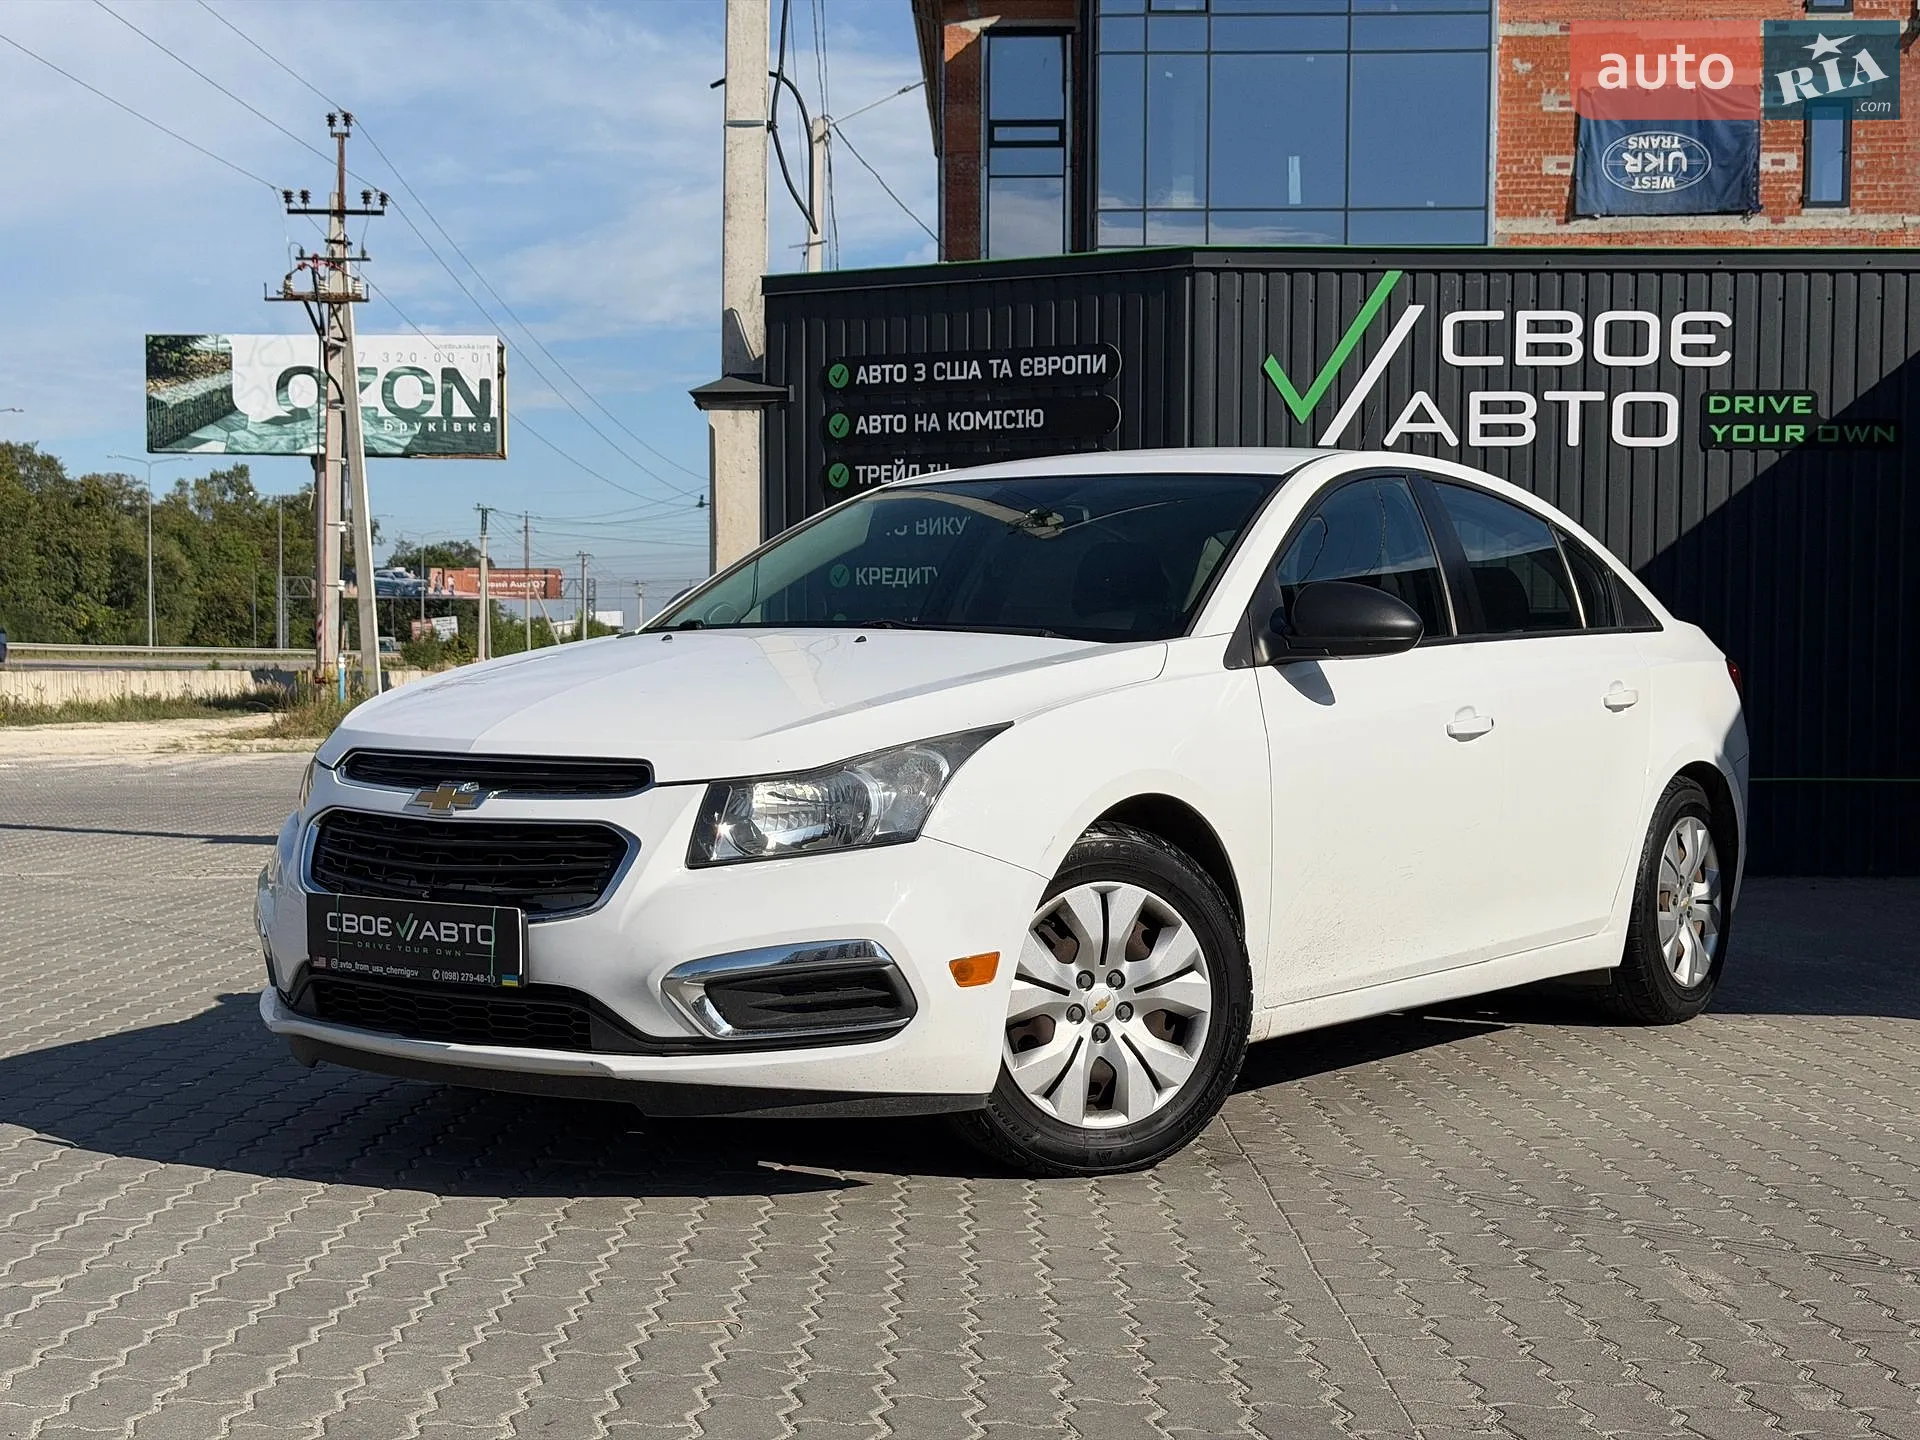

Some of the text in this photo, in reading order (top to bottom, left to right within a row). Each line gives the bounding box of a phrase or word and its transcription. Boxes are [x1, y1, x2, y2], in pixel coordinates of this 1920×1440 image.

[1628, 135, 1681, 149] TRANS
[1622, 151, 1688, 173] UKR
[1632, 176, 1676, 190] WEST
[1442, 310, 1733, 367] СВОЄ
[382, 352, 491, 363] 320-00-01
[856, 364, 907, 385] АВТО
[933, 360, 982, 381] США
[988, 358, 1012, 378] ТА
[1020, 354, 1107, 378] ЄВРОПИ
[1709, 396, 1812, 414] DRIVE
[856, 408, 1044, 435] АВТО НА КОМІСІЮ
[1383, 390, 1679, 447] АВТО
[1709, 424, 1895, 443] YOUR OWN
[916, 516, 971, 535] ВИКУ
[855, 566, 938, 588] КРЕДИТ
[420, 920, 496, 946] АВТО
[357, 941, 461, 957] DRIVE YOUR OWN
